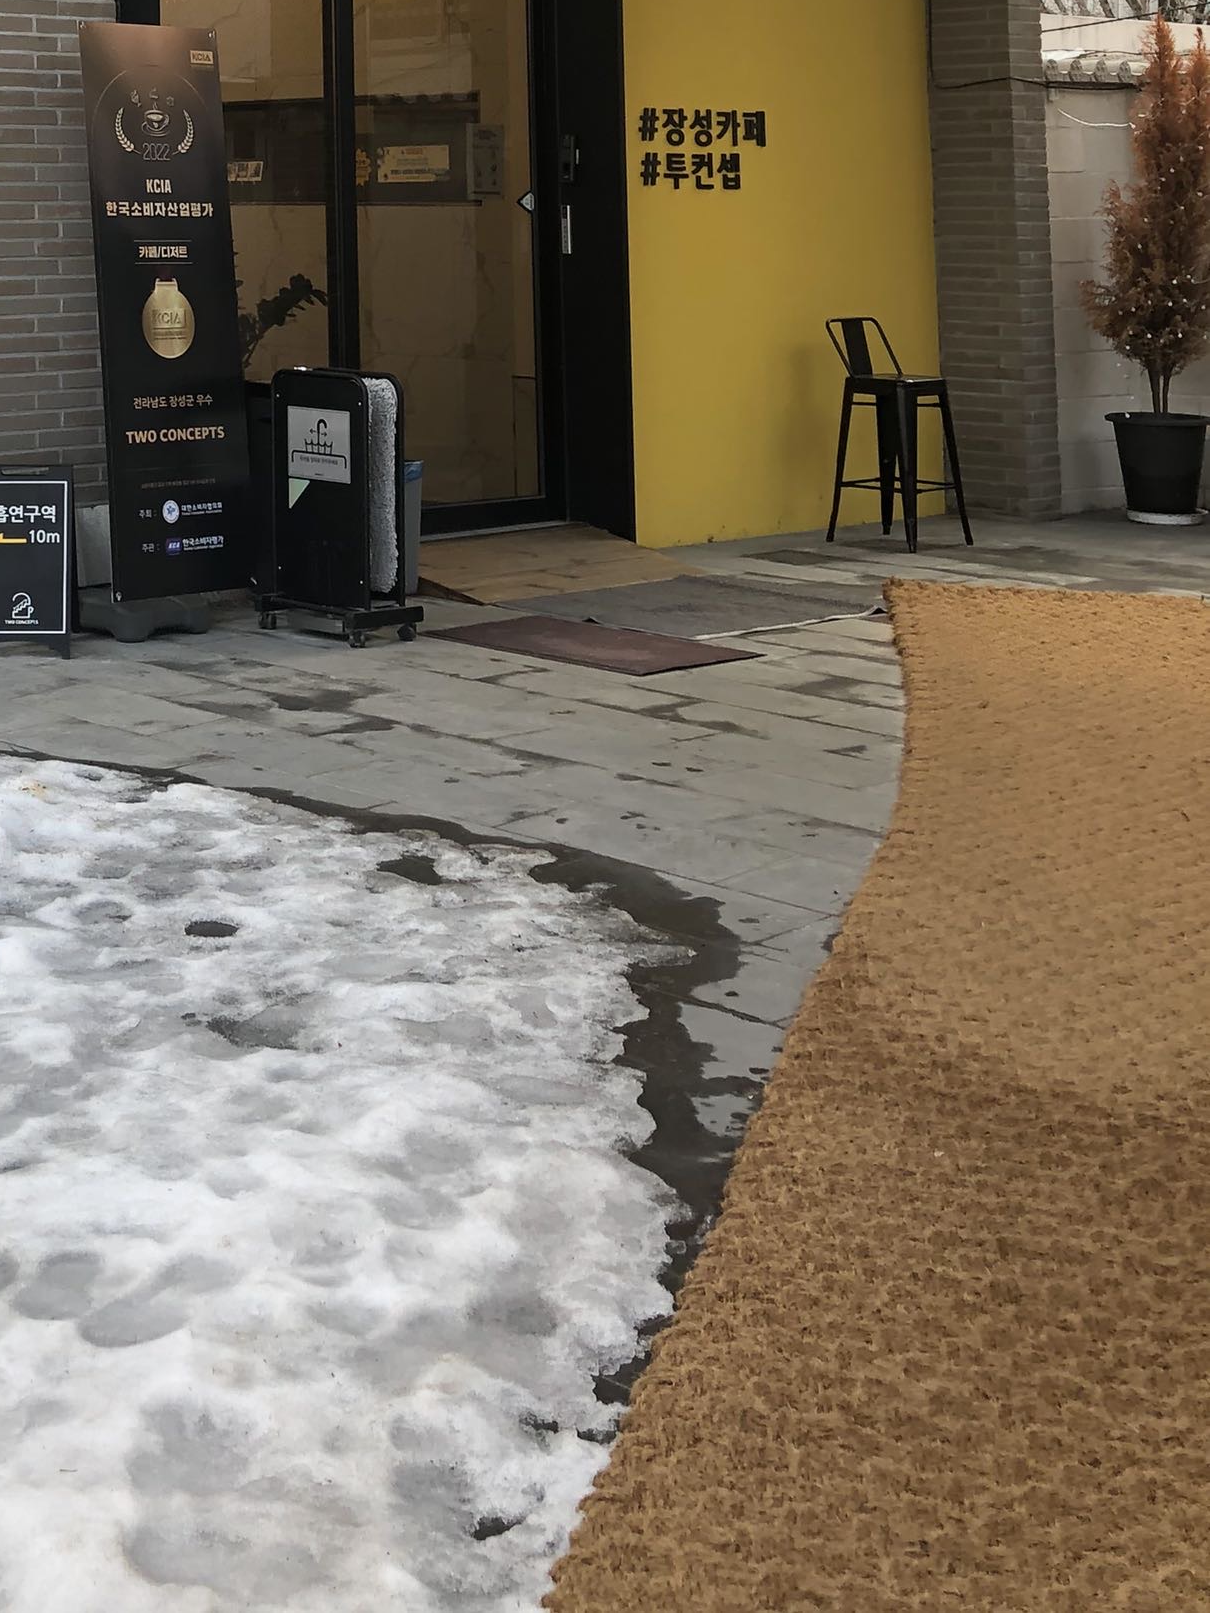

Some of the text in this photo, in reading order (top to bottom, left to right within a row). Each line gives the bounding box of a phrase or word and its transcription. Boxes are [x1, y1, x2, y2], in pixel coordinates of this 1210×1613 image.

[638, 107, 766, 147] #장성카페
[142, 143, 171, 161] 2022
[640, 152, 741, 190] #투컨셉
[146, 179, 172, 194] KCIA
[106, 201, 214, 217] 한국소비자산업평가
[139, 245, 188, 259] 카페/디저트
[133, 393, 213, 410] 전라남도 장성군 우수
[126, 426, 225, 444] TWO CONCEPTS
[29, 529, 60, 544] 10m
